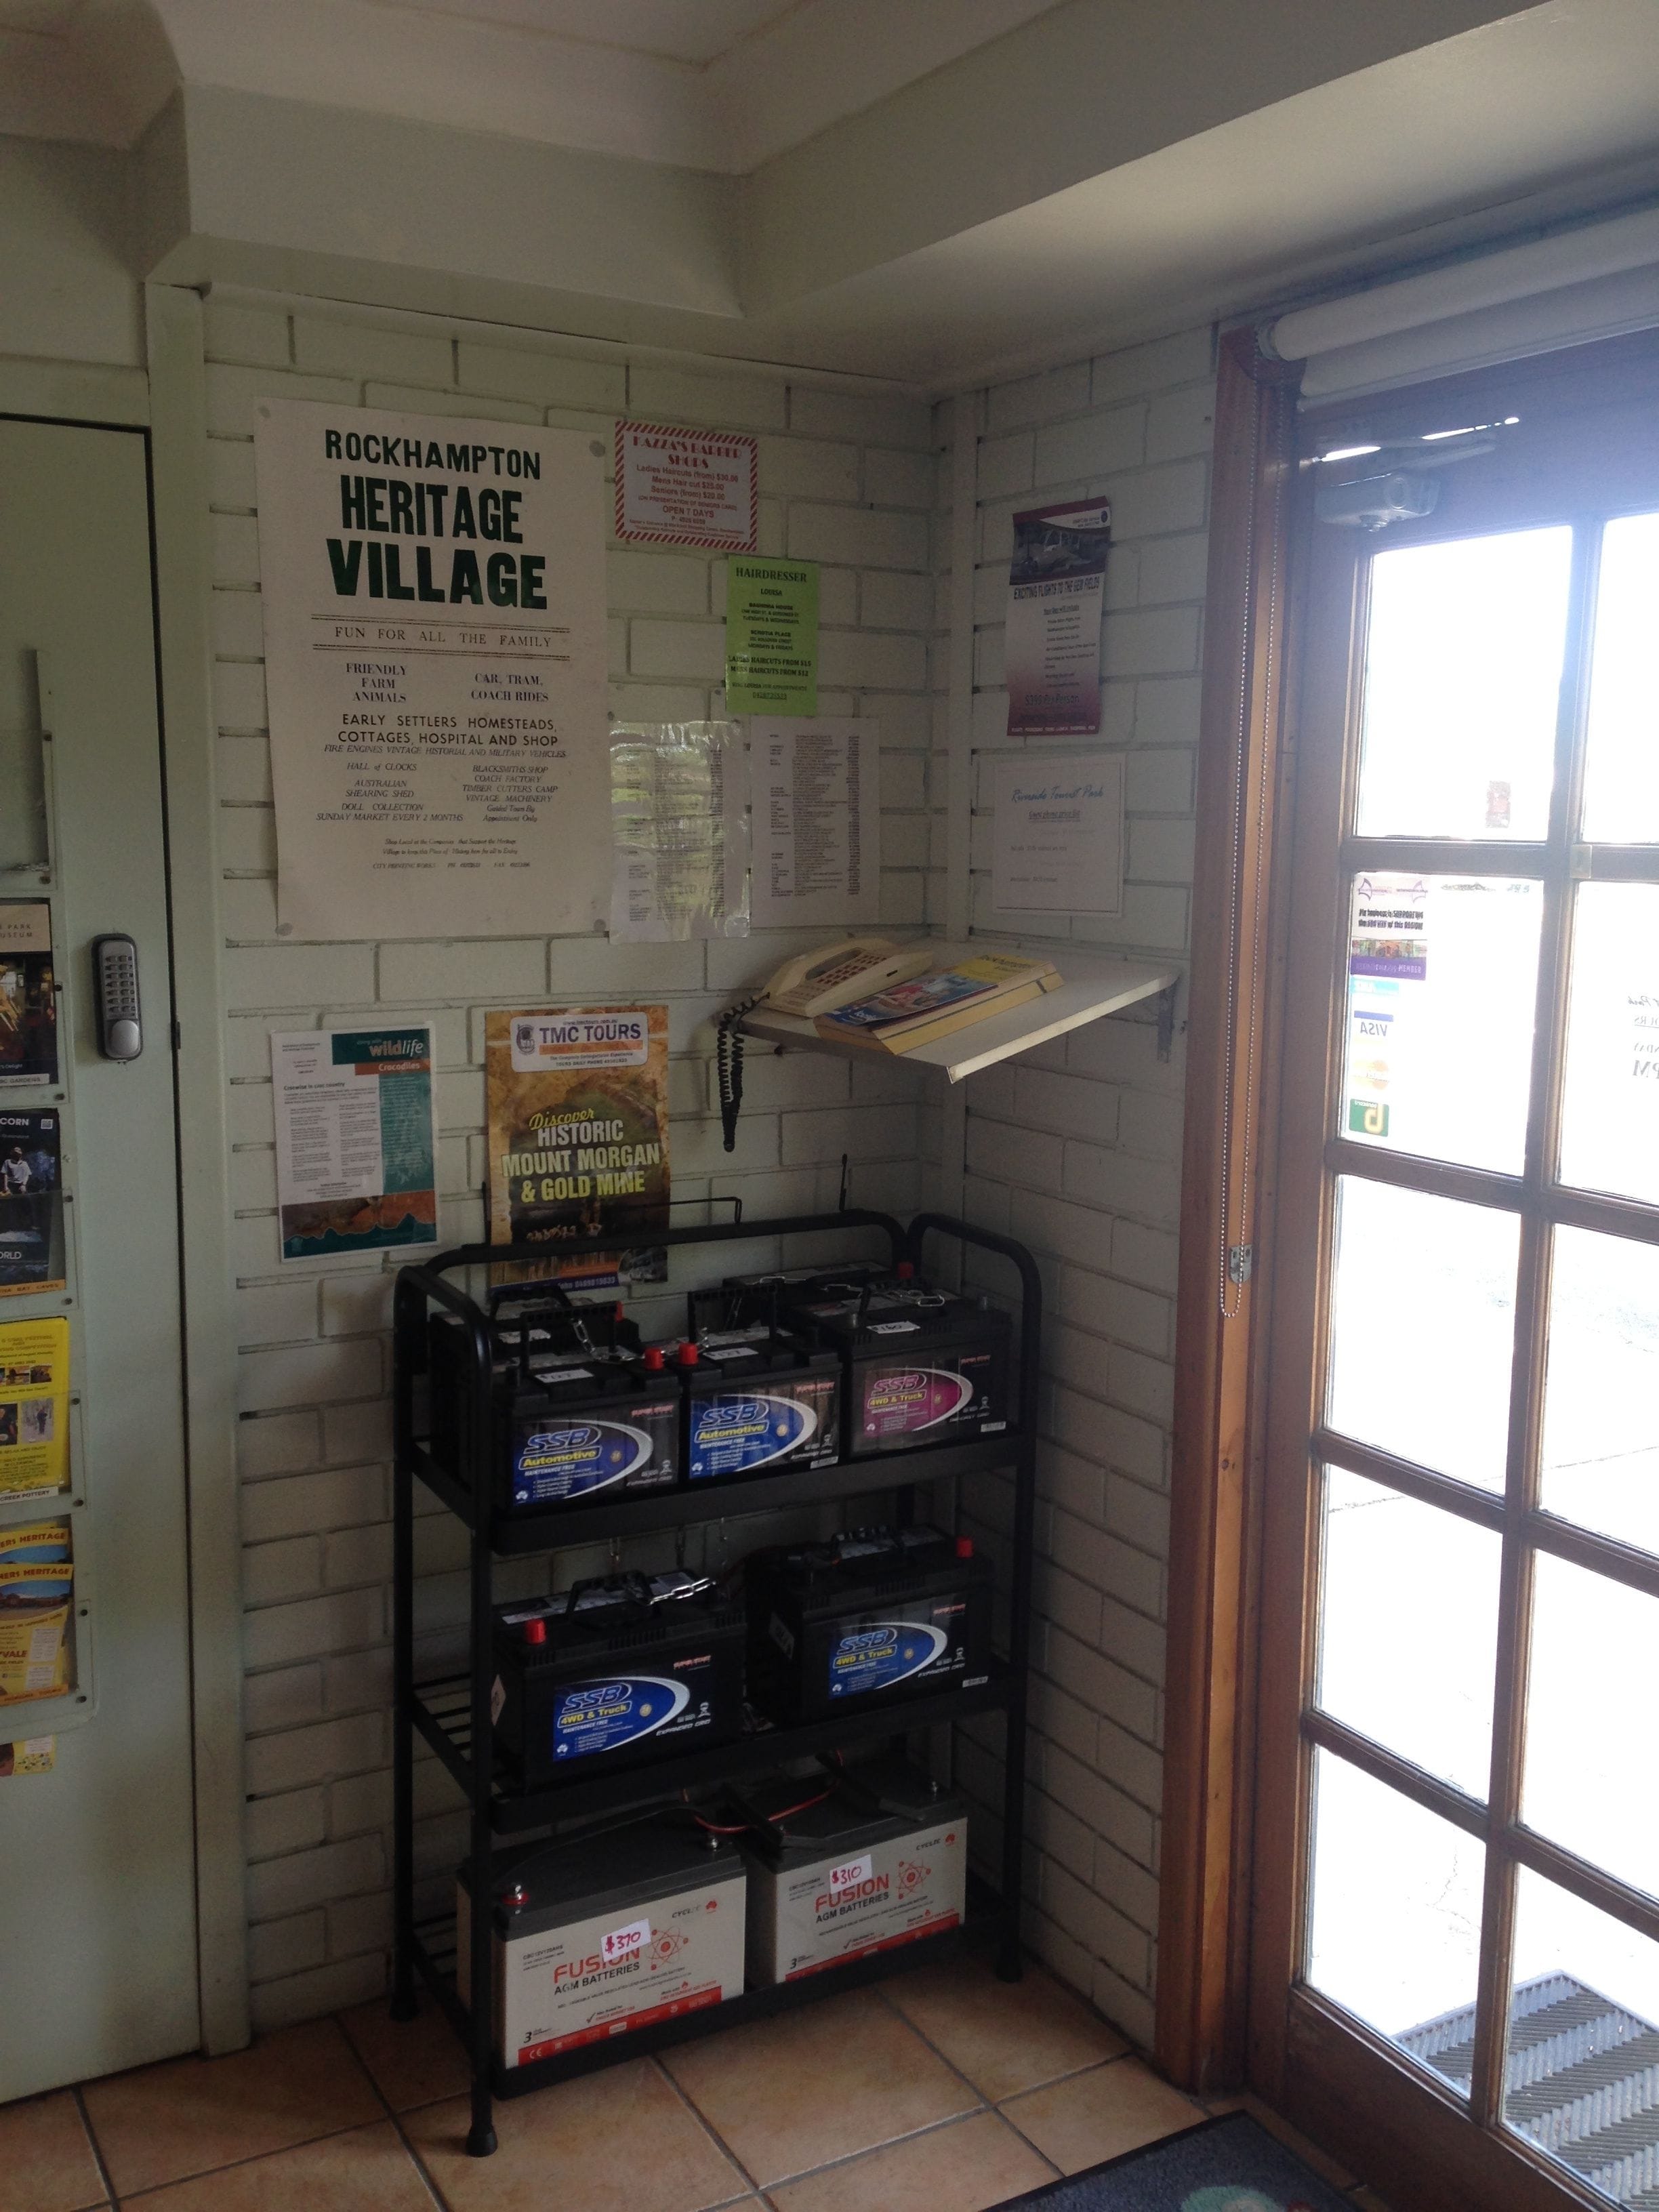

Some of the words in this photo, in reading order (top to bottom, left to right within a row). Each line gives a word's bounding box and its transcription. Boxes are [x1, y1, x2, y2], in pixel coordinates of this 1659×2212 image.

[325, 429, 540, 480] ROCKHAMPTON
[691, 443, 742, 459] BARBER
[636, 464, 660, 473] Ladies
[663, 466, 692, 477] Haircuts
[652, 476, 671, 485] Mens
[673, 478, 687, 487] Hair
[341, 474, 523, 544] HERITAGE
[662, 506, 684, 515] OPEN
[693, 508, 714, 518] DAYS
[326, 538, 548, 610] VILLAGE
[736, 567, 807, 583] HAIRDRESSER
[760, 588, 783, 596] LOUISA
[335, 626, 365, 638] FUN
[378, 628, 405, 640] FOR
[419, 631, 445, 642] ALL
[459, 633, 486, 644] THE
[499, 635, 551, 647] FAMILY
[346, 662, 407, 676] FRIENDLY
[751, 657, 782, 665] HAIRCUTS
[749, 667, 779, 675] HAIRCUTS
[362, 678, 395, 689] FARM
[352, 693, 407, 703] ANIMALS
[471, 690, 511, 701] COACH
[516, 691, 549, 702] RIDES
[342, 714, 386, 726] EARLY
[397, 715, 457, 727] SETTLERS
[468, 718, 557, 732] HOMESTEADS,
[338, 731, 414, 745] COTTAGES,
[419, 733, 483, 745] HOSPITAL
[489, 734, 517, 745] AND
[523, 735, 558, 746] SHOP
[324, 745, 344, 753] FIRE
[387, 746, 422, 755] VINTAGE
[468, 748, 486, 756] AND
[488, 748, 526, 758] MILITARY
[530, 750, 567, 758] VEHICLES
[347, 762, 369, 771] HALL
[374, 762, 381, 771] of
[385, 762, 417, 771] CLOCKS
[527, 766, 548, 774] SHOP
[354, 779, 407, 788] AUSTRALIAN
[463, 784, 492, 792] TIMBER
[345, 790, 388, 798] SHEARING
[392, 790, 415, 798] SHED
[466, 794, 499, 802] VINTAGE
[341, 803, 364, 811] DOLL
[372, 803, 424, 812] COLLECTION
[316, 813, 350, 821] SUNDAY
[352, 813, 389, 821] MARKET
[392, 813, 421, 821] EVERY
[431, 813, 464, 822] MONTHS
[539, 1026, 579, 1043] TMC
[584, 1023, 641, 1041] TOURS
[369, 1040, 424, 1057] wildlife
[379, 1062, 420, 1071] Crocodiles
[529, 1108, 594, 1130] Discover
[537, 1119, 623, 1147] HISTORIC
[501, 1150, 571, 1178] MOUNT
[577, 1143, 659, 1172] MORGAN
[520, 1180, 535, 1203] &
[541, 1176, 591, 1202] GOLD
[596, 1170, 645, 1197] MINE
[874, 1374, 920, 1391] SSB
[869, 1398, 889, 1408] 4WD
[900, 1393, 924, 1401] Truck
[702, 1403, 759, 1425] SSB
[526, 1427, 591, 1452] SSB
[698, 1424, 765, 1441] Automotive
[523, 1450, 597, 1467] Automotive
[20, 1532, 65, 1542] HERITAGE
[839, 1629, 889, 1652] SSB
[836, 1656, 857, 1666] 4WD
[859, 1653, 865, 1661] &
[867, 1647, 893, 1659] Truck
[565, 1684, 623, 1711] SSB
[560, 1713, 583, 1725] 4WD
[587, 1711, 595, 1719] &
[598, 1704, 628, 1717] Truck
[832, 1866, 862, 1885] $310
[815, 1874, 889, 1914] FUSION
[816, 1910, 837, 1924] AGM
[840, 1891, 889, 1916] BATTERIES
[605, 1931, 641, 1954] $370
[553, 1948, 640, 1984] FUSON
[790, 1958, 797, 1969] 3
[554, 1980, 580, 1996] AGM
[582, 1962, 640, 1986] BATTERIES
[524, 2032, 532, 2043] 3
